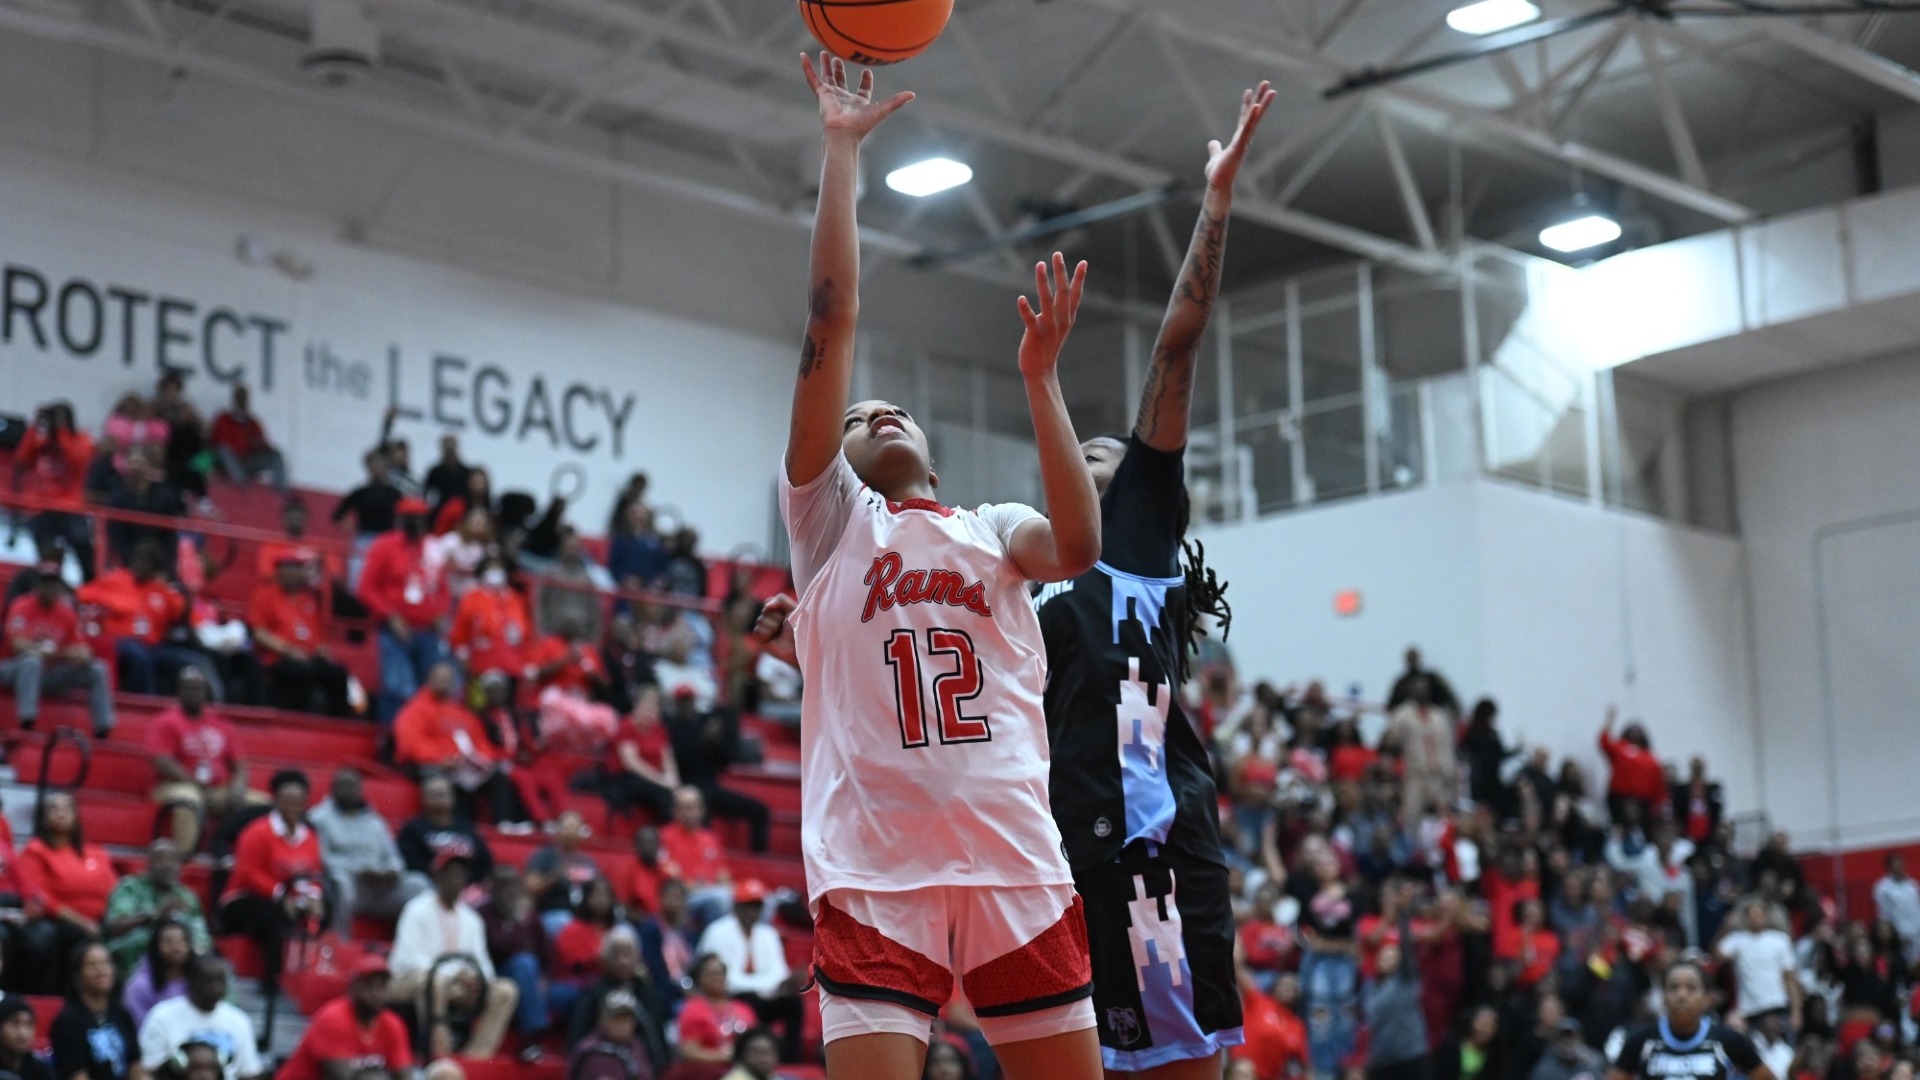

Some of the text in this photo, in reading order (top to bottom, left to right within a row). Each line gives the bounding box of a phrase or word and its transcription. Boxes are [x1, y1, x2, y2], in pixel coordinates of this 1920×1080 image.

[303, 342, 371, 400] the
[387, 346, 636, 461] LEGACY
[861, 552, 994, 623] Rams
[884, 628, 992, 749] 12
